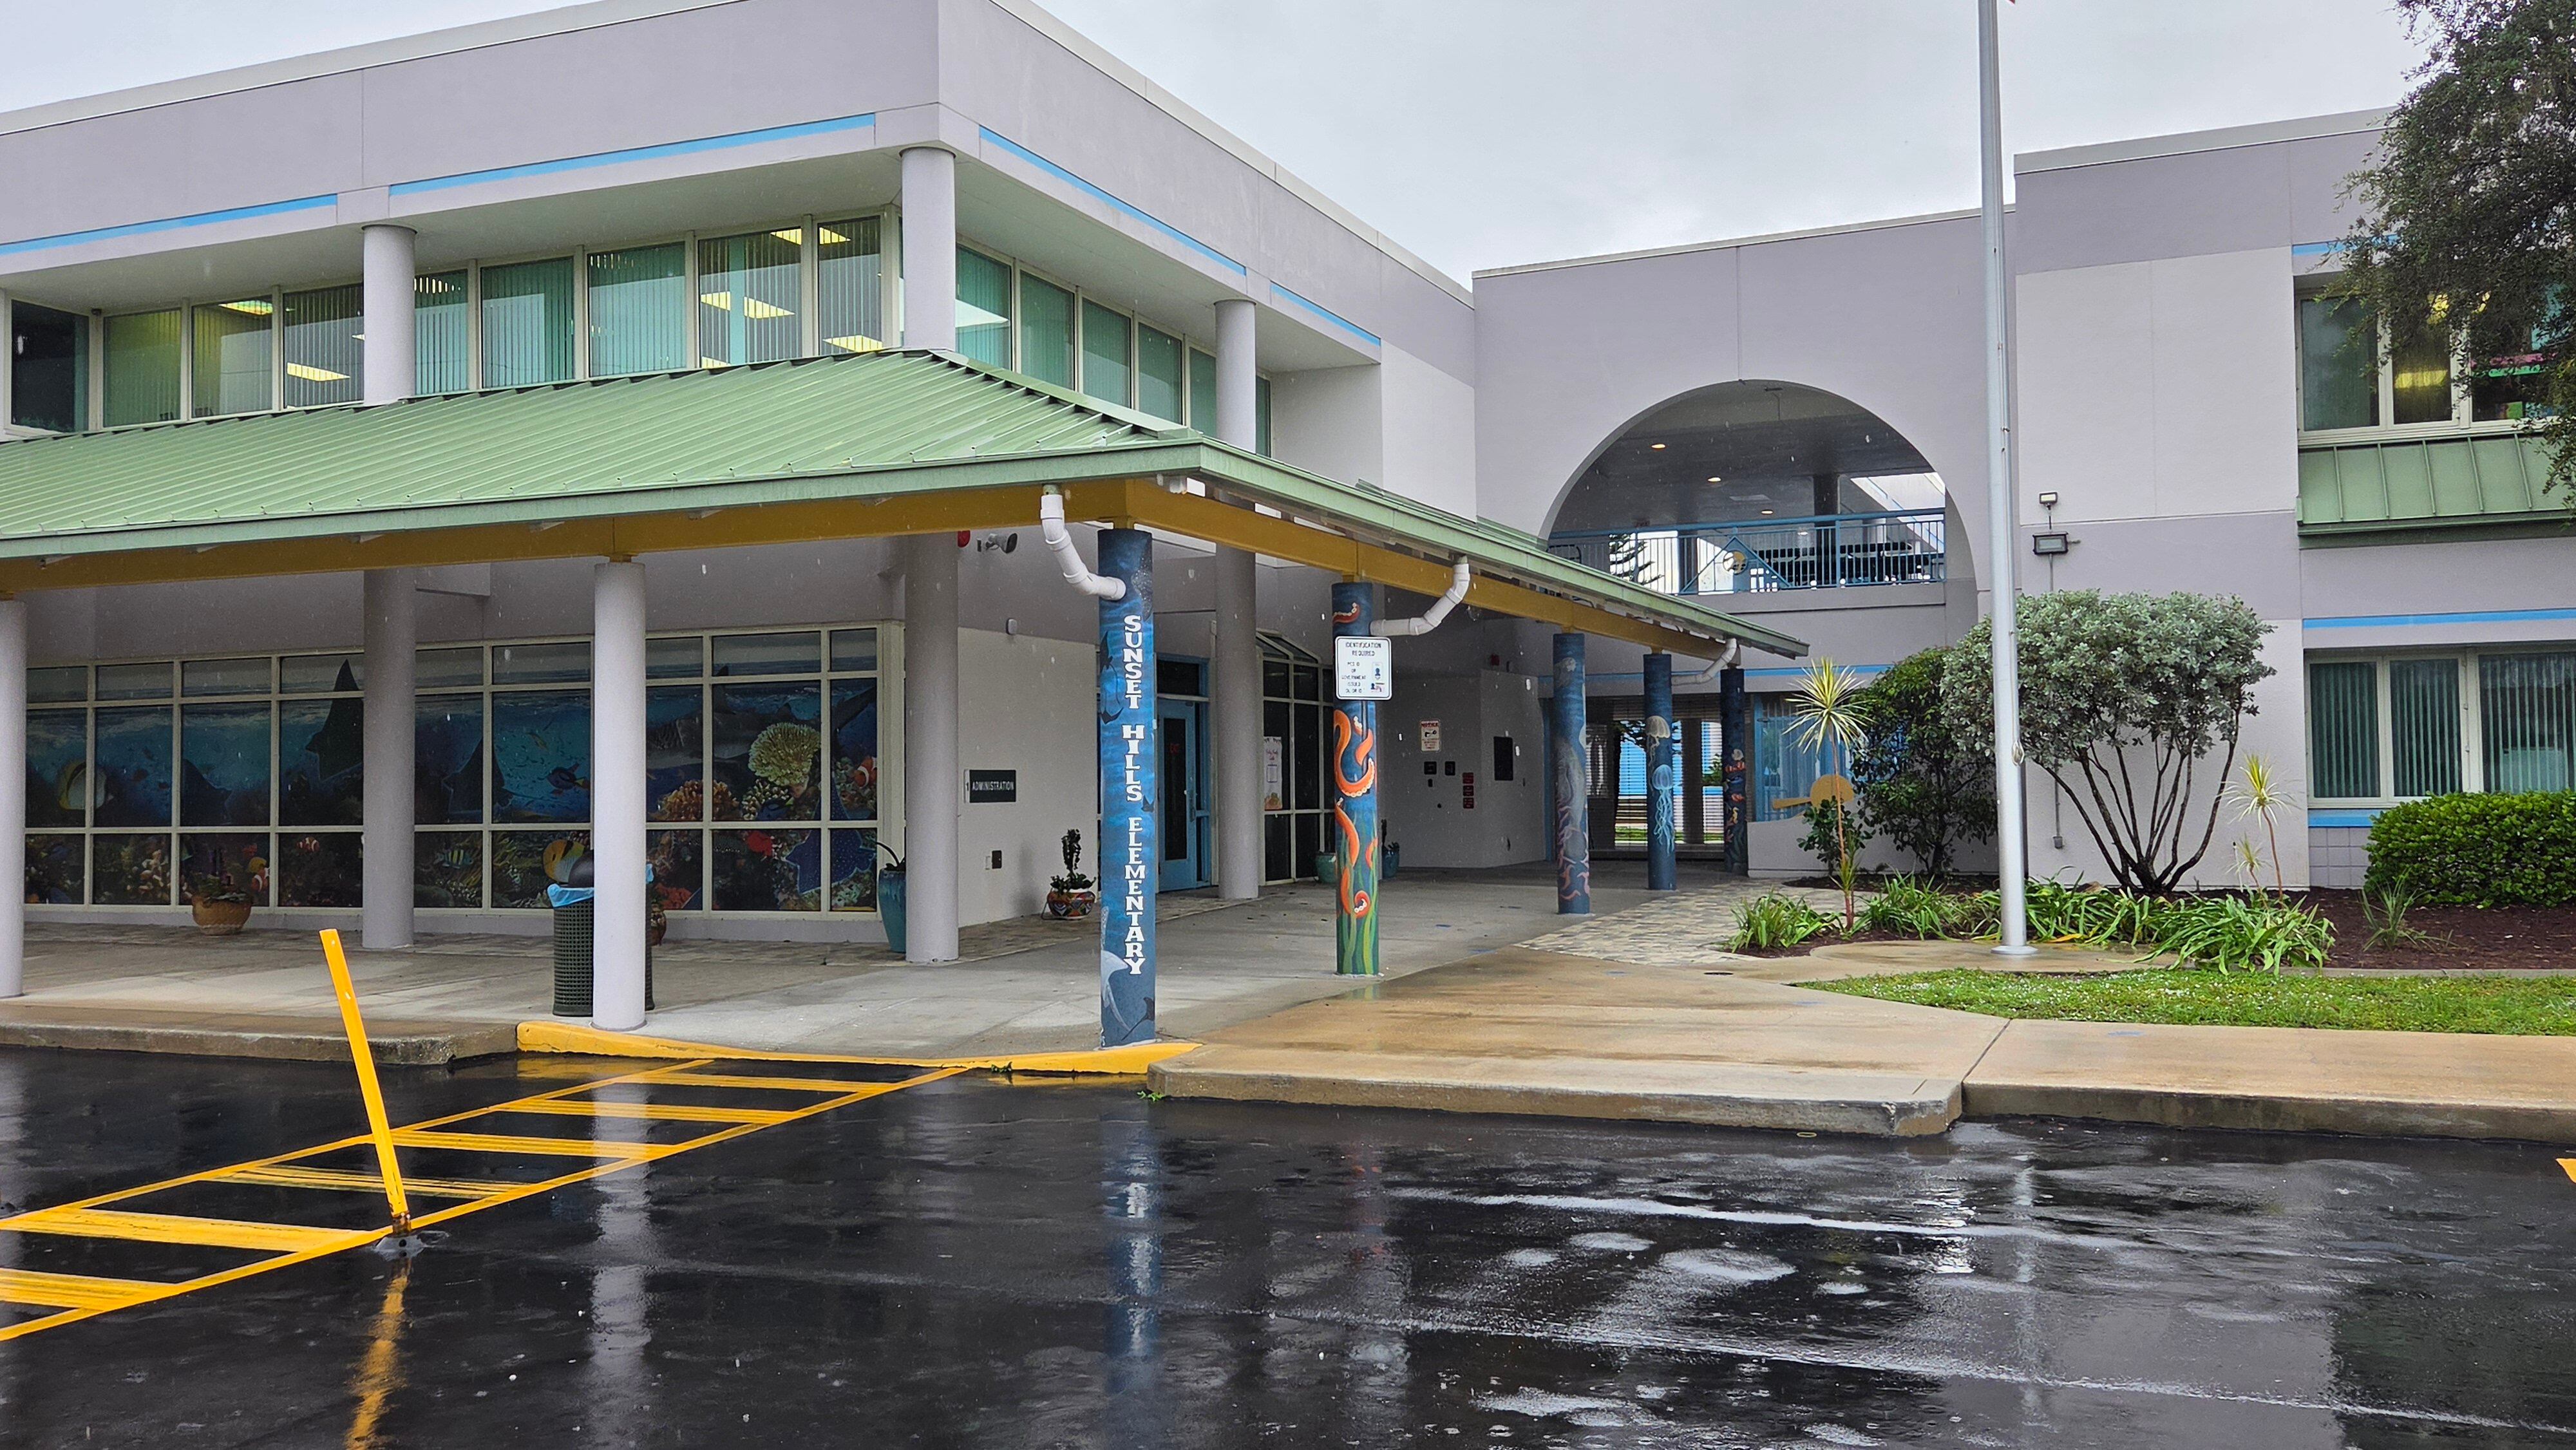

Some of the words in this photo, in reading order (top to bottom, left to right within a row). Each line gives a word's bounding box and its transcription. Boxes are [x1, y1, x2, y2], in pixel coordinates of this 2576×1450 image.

[1123, 615, 1143, 709] SUNSET
[972, 781, 1014, 791] ADMINISTRATION
[1122, 725, 1145, 802] HILLS
[1123, 817, 1146, 975] ELEMENTARY
